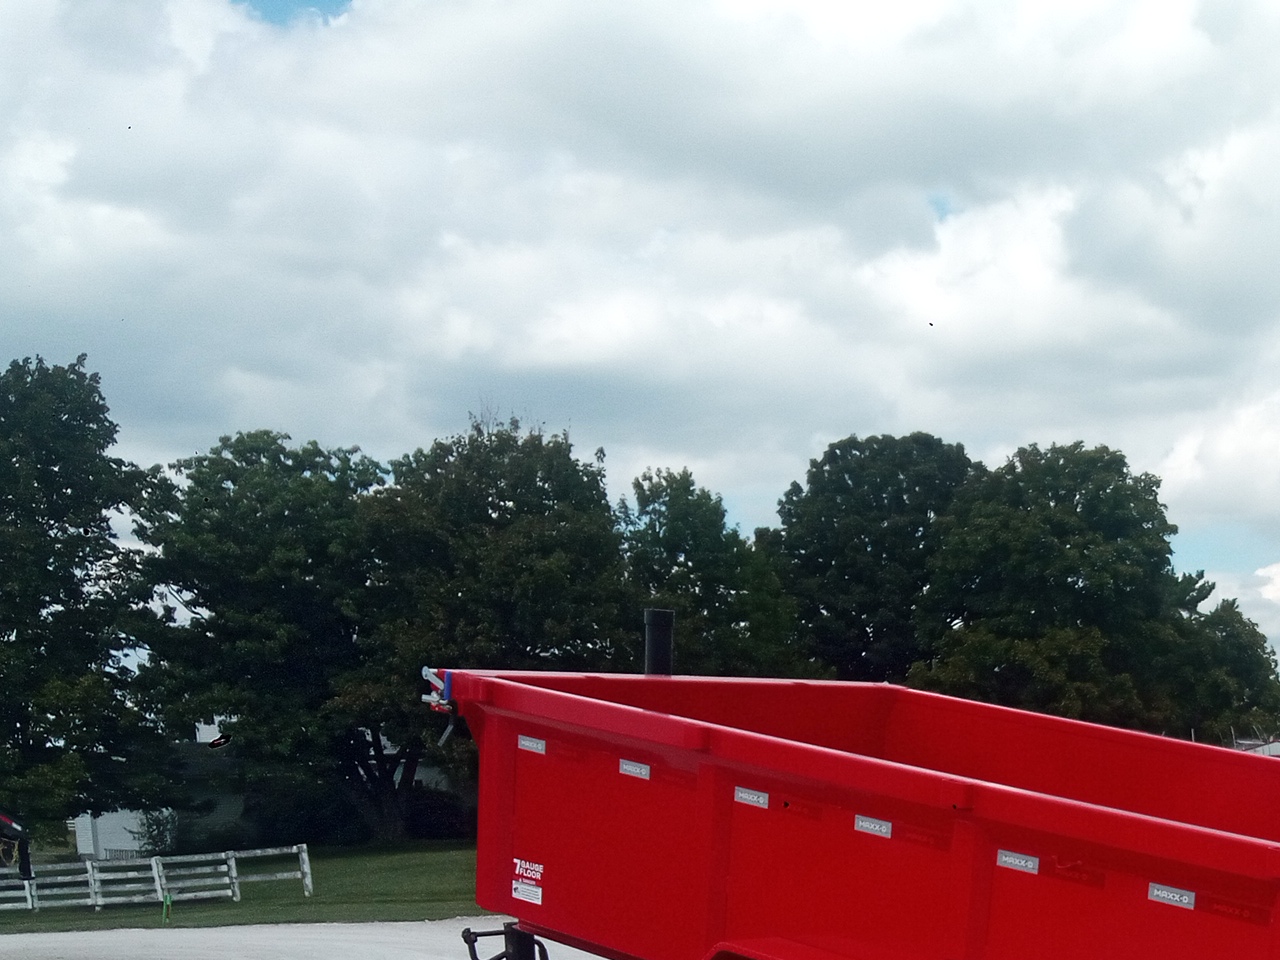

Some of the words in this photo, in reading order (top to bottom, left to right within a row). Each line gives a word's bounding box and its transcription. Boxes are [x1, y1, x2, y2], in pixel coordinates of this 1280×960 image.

[738, 791, 765, 804] MAXX-D
[858, 820, 887, 833] MAXX-D
[513, 857, 521, 875] 7
[520, 860, 544, 873] GAUGE
[1002, 855, 1034, 868] MAXX-D
[519, 867, 542, 880] FLOOR
[1153, 888, 1190, 904] MAXX-D
